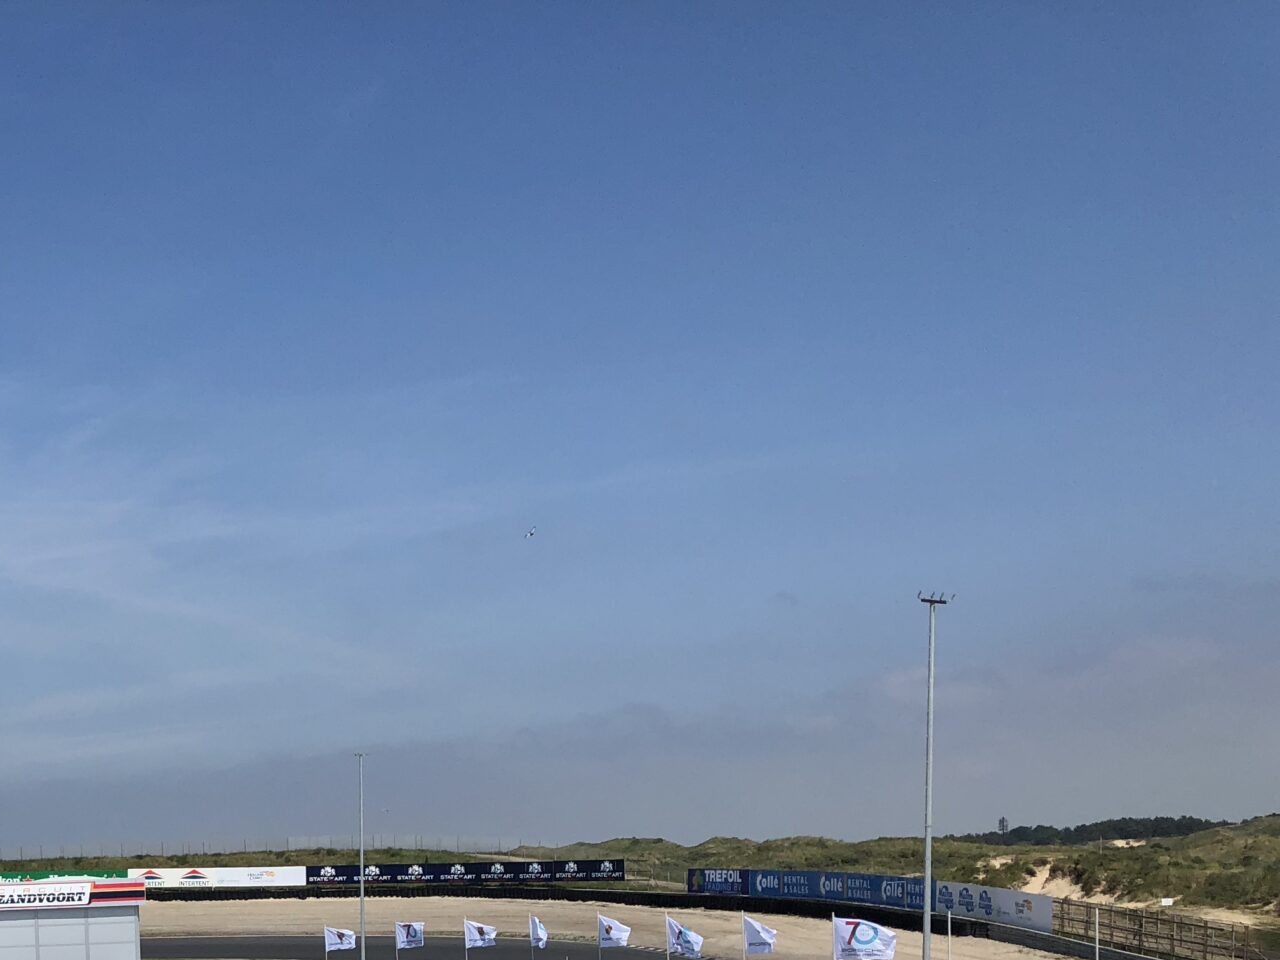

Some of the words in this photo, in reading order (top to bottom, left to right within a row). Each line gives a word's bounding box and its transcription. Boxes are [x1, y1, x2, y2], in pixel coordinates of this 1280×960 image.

[704, 870, 742, 882] TREFOIL
[784, 876, 808, 885] RENTAL
[704, 882, 731, 891] TRADING
[756, 874, 778, 892] Collé
[820, 876, 843, 895] Collé
[848, 879, 870, 888] RENTAL
[881, 880, 902, 900] Collé
[907, 884, 924, 893] RENT
[852, 890, 870, 898] SALES
[912, 896, 924, 904] SAL
[846, 921, 878, 945] 70
